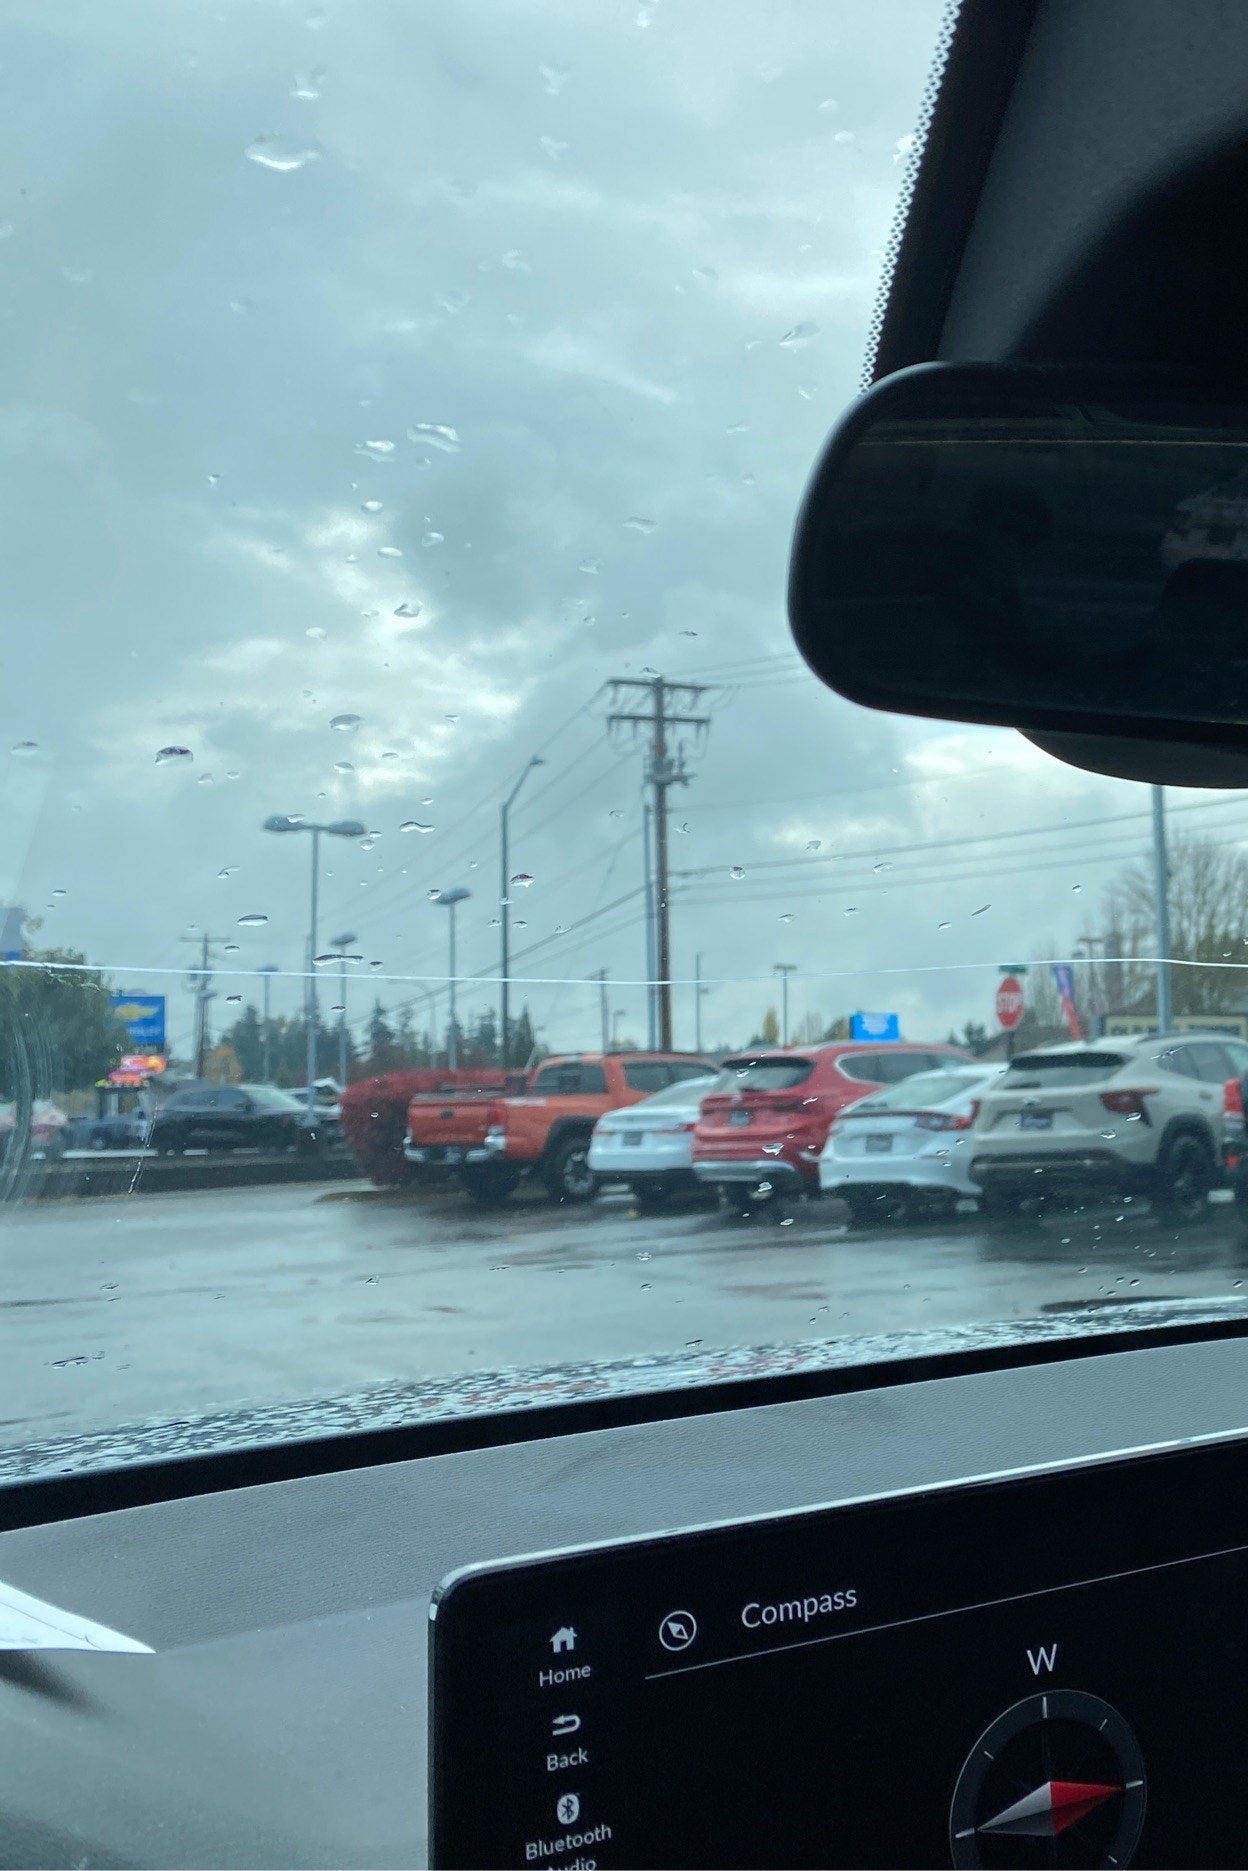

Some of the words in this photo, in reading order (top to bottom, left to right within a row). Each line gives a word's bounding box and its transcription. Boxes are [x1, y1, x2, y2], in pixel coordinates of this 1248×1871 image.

[997, 992, 1023, 1013] STOP
[741, 1589, 857, 1628] Compass
[1026, 1643, 1057, 1675] W
[539, 1665, 591, 1687] Home
[546, 1747, 588, 1771] Back
[525, 1823, 612, 1860] Bluetooth
[547, 1857, 597, 1871] dio
